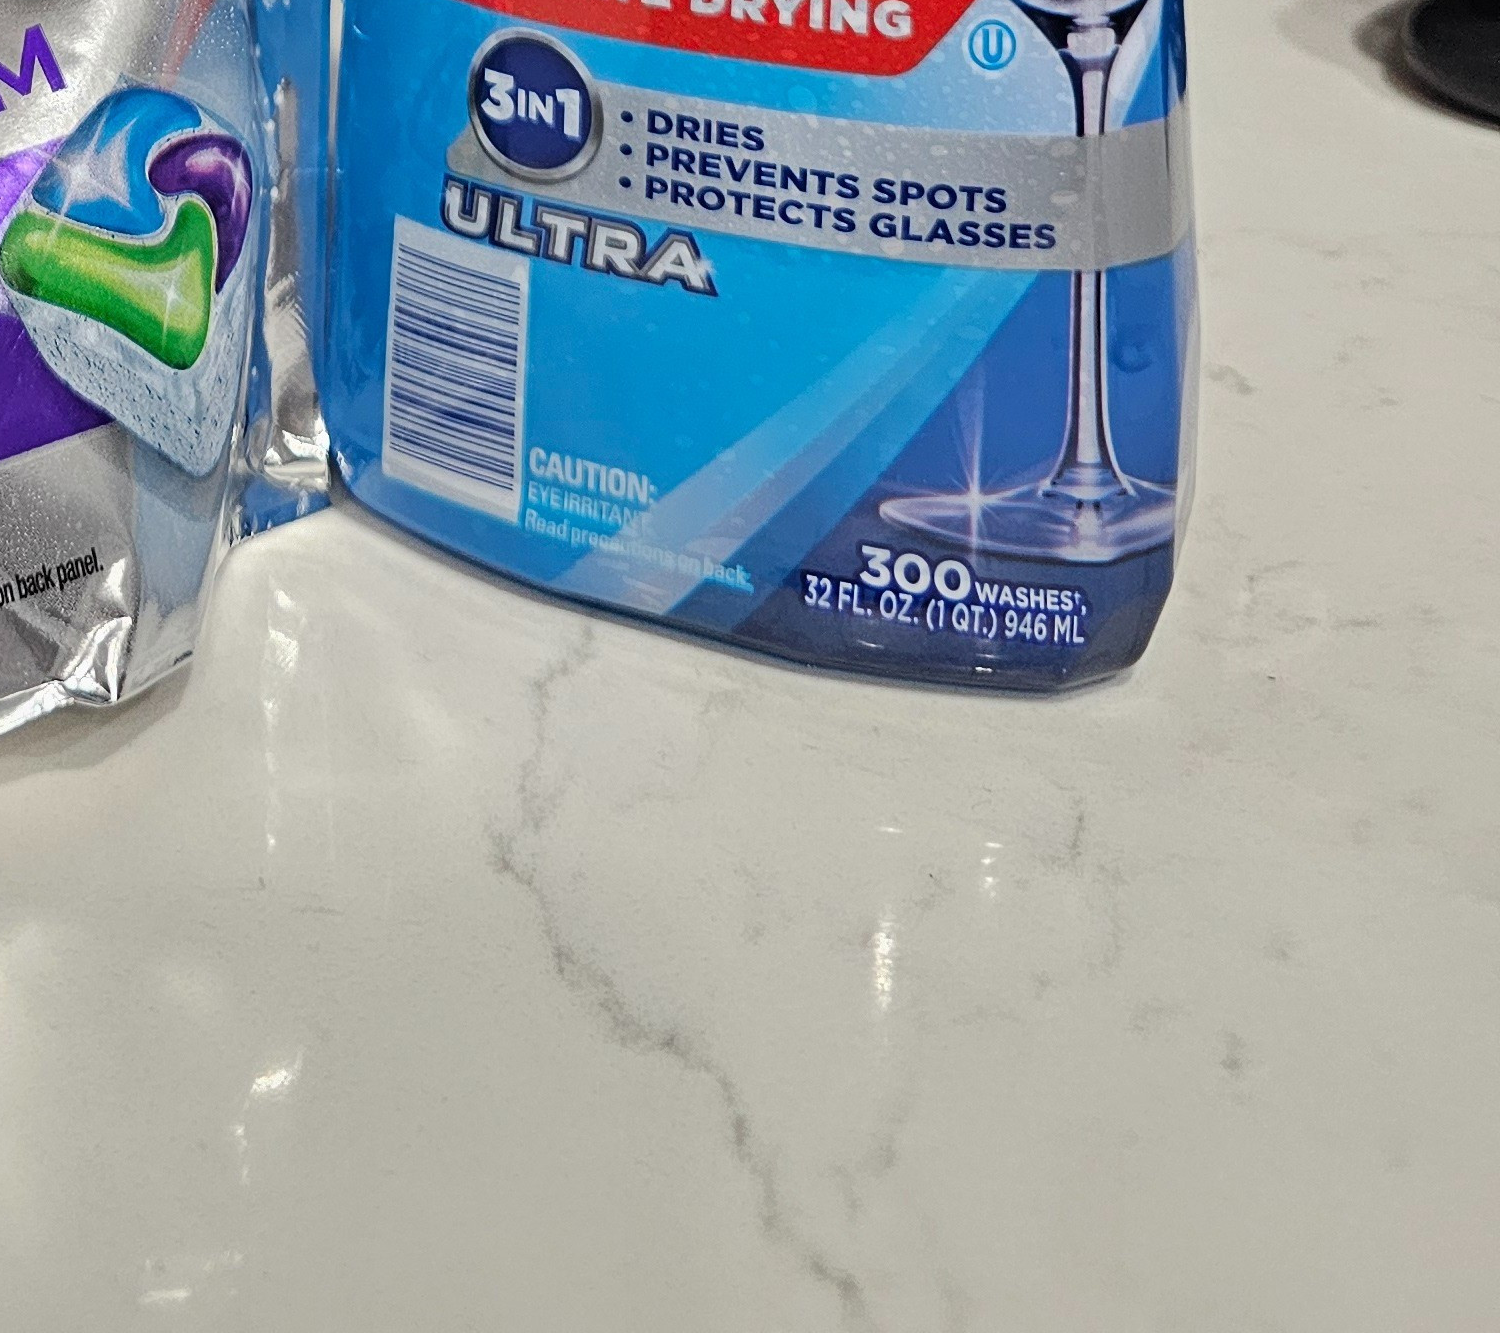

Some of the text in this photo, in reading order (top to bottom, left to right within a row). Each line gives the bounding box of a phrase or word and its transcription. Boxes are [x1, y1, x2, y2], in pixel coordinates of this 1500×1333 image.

[646, 108, 766, 153] DRIES
[645, 141, 1008, 214] PREVENTS SPOTS
[443, 179, 715, 294] ULTRA
[645, 175, 1057, 251] PROTECTS GLASSES
[528, 446, 658, 506] CAUTION:
[524, 507, 570, 538] Read
[527, 480, 653, 533] EYE IRRITANT
[15, 563, 56, 600] back
[55, 545, 104, 594] panel.
[859, 544, 971, 601] 300
[804, 573, 1085, 644] 32 FL. OZ. (1 QT.) 946 ML
